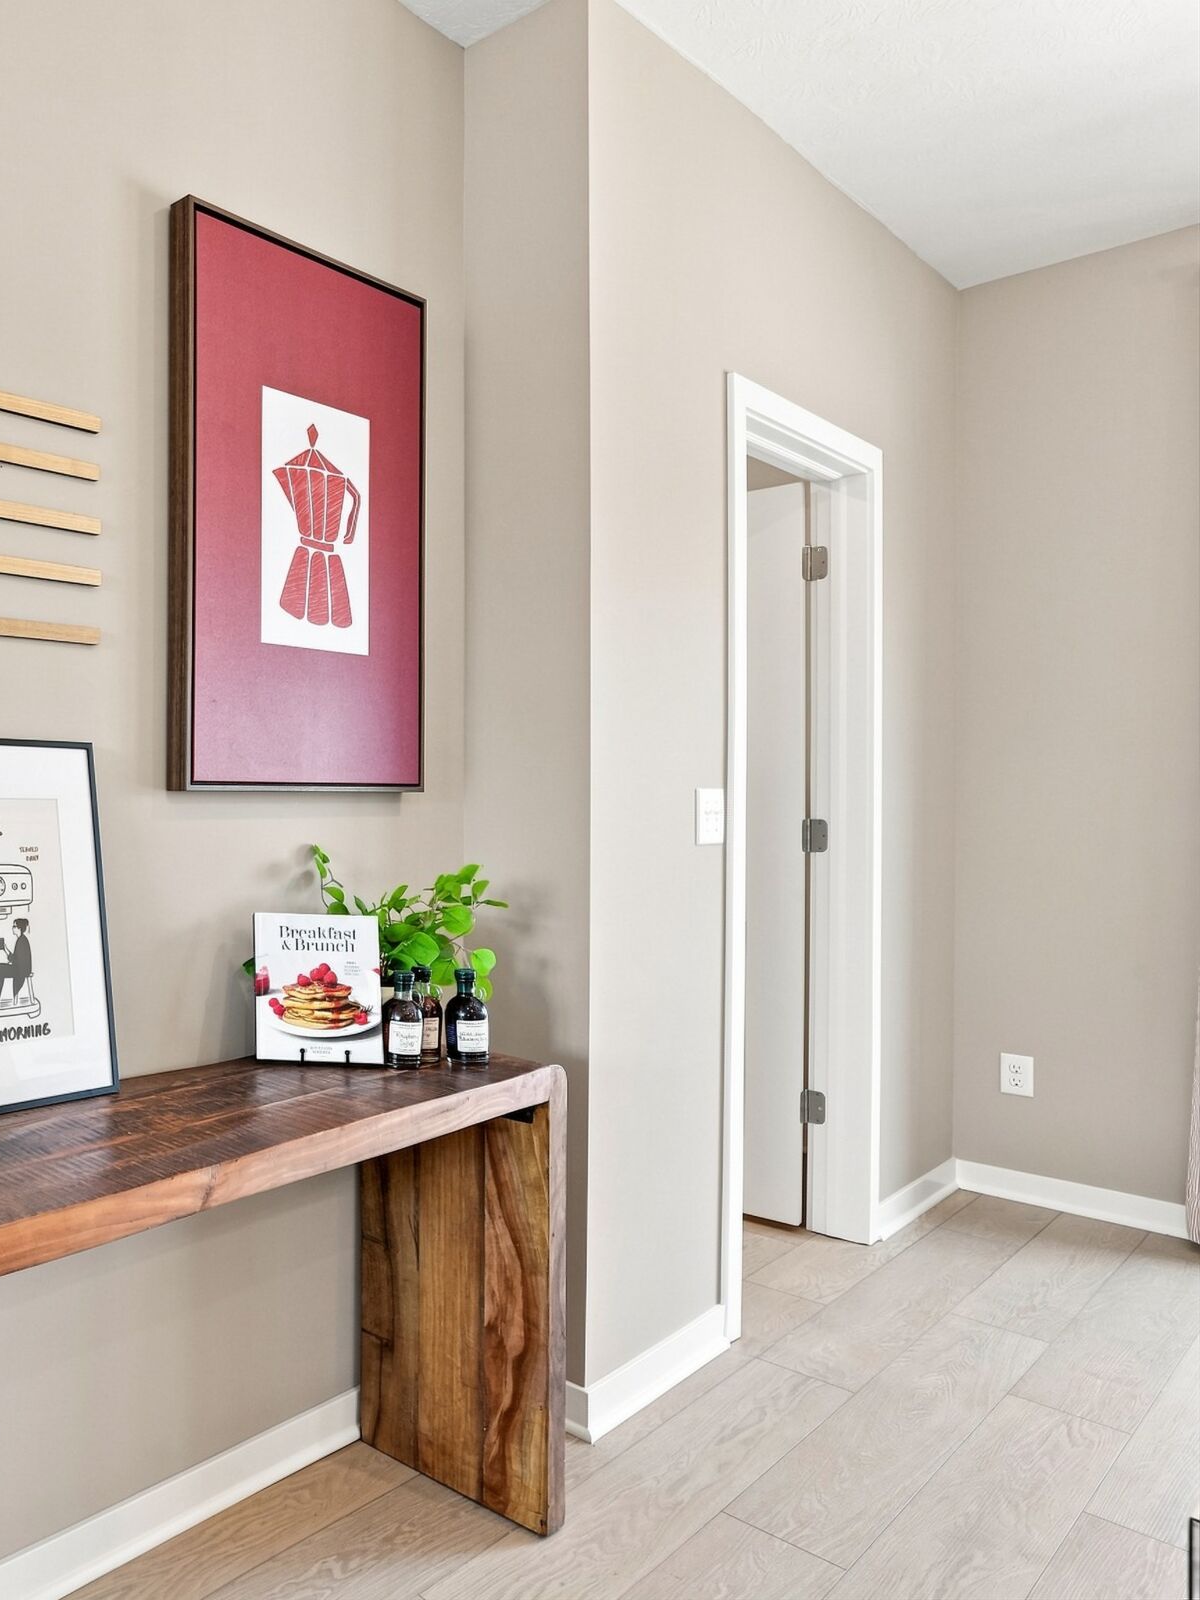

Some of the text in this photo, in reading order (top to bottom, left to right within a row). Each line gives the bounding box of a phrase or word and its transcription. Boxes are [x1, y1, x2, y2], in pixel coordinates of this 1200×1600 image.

[279, 925, 356, 940] Breakfast
[295, 938, 355, 953] Brunch
[0, 1022, 51, 1042] MORNING
